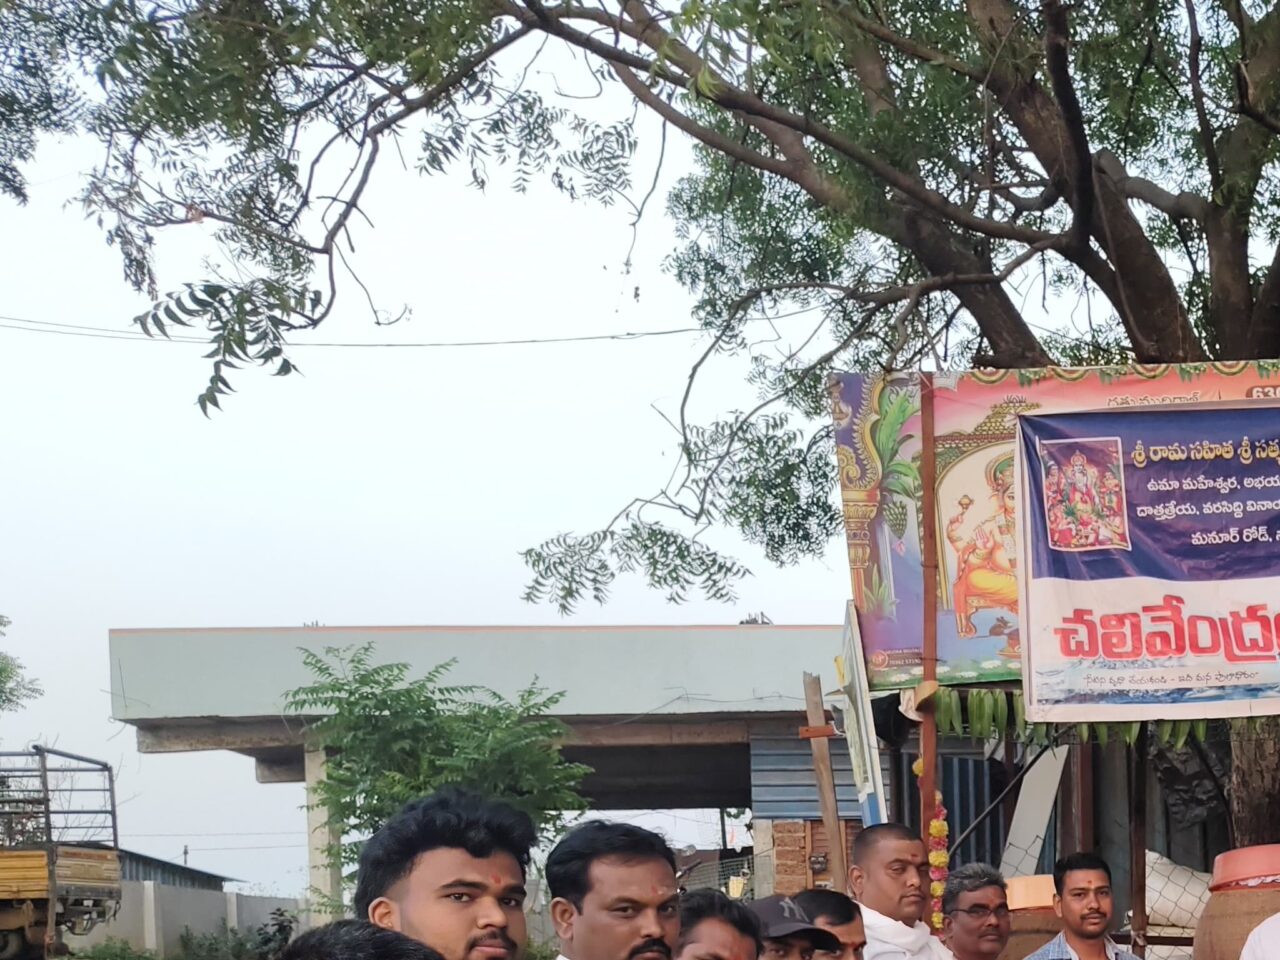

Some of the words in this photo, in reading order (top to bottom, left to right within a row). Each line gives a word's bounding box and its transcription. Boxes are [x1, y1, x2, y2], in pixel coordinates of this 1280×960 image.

[1131, 439, 1147, 468] శ్రీ
[1149, 442, 1187, 462] రామ
[1189, 440, 1234, 460] సహిత
[1238, 436, 1252, 464] శ్రీ
[1147, 478, 1180, 491] ఉమా
[1182, 474, 1241, 494] మహేశ్వర,
[1191, 527, 1240, 545] మనూర్
